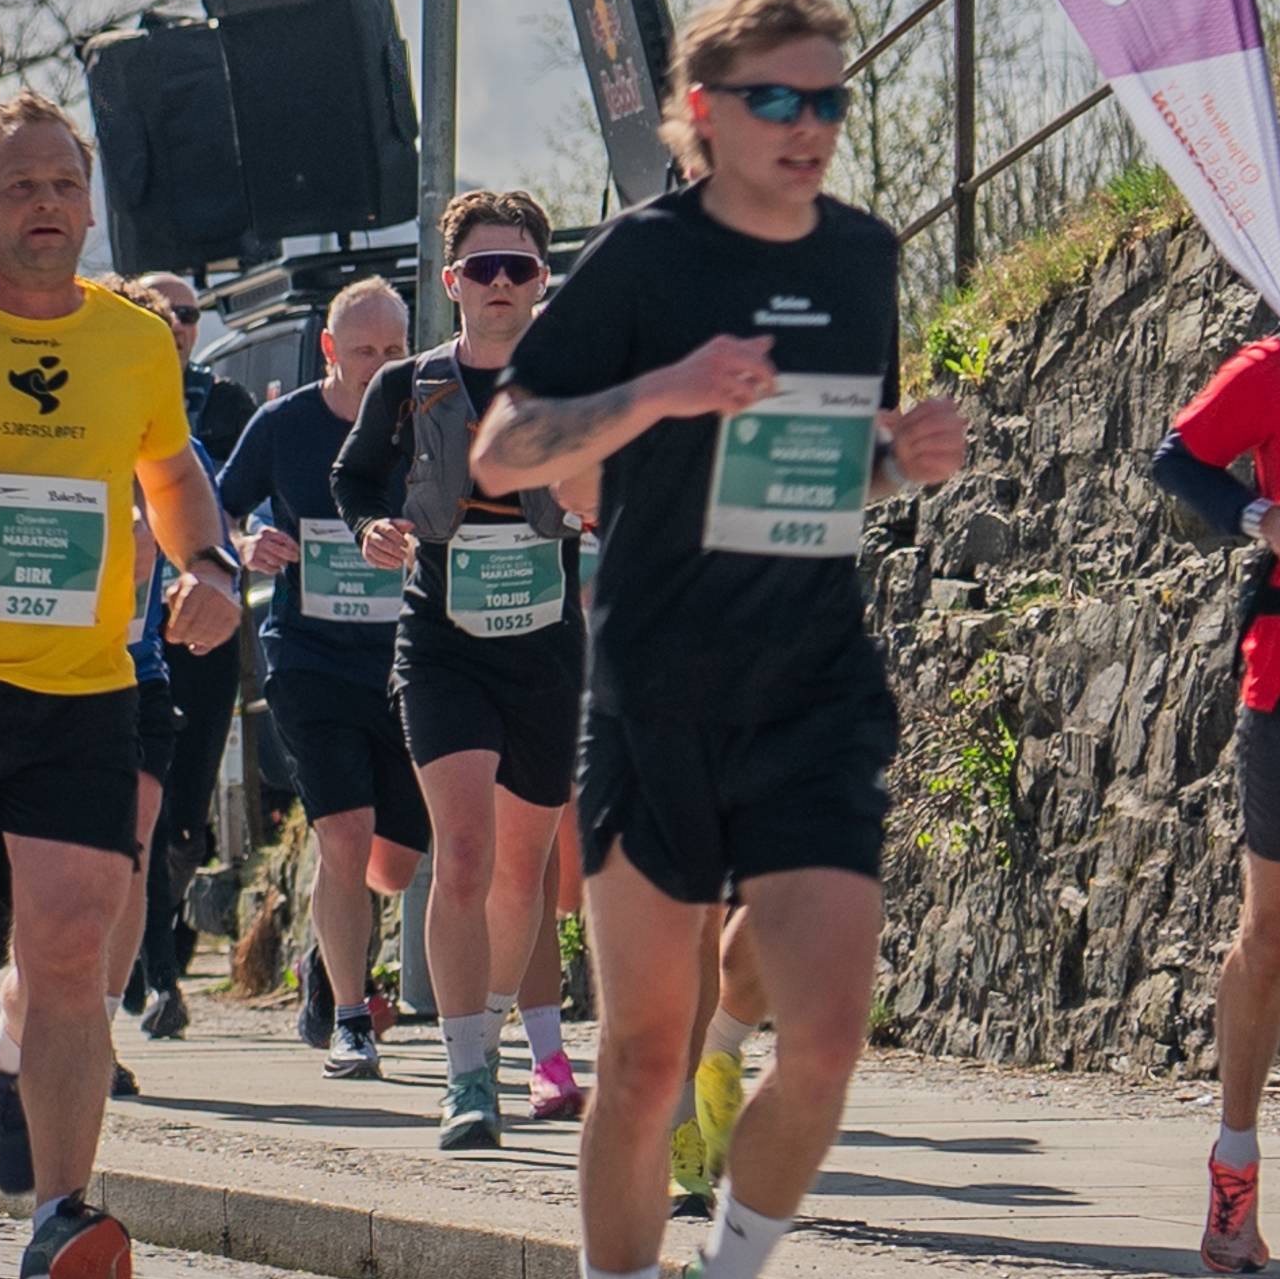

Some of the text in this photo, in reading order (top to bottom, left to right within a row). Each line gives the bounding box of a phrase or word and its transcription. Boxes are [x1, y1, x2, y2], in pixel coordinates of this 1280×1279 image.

[2, 534, 69, 549] MARATHON
[770, 521, 827, 547] 6892
[14, 566, 52, 584] BIRK
[481, 568, 533, 580] MARATHON
[338, 581, 366, 595] PAUL
[6, 596, 58, 617] 3267
[486, 591, 531, 608] TORJUS
[332, 602, 370, 616] 8270
[486, 613, 533, 632] 10525
